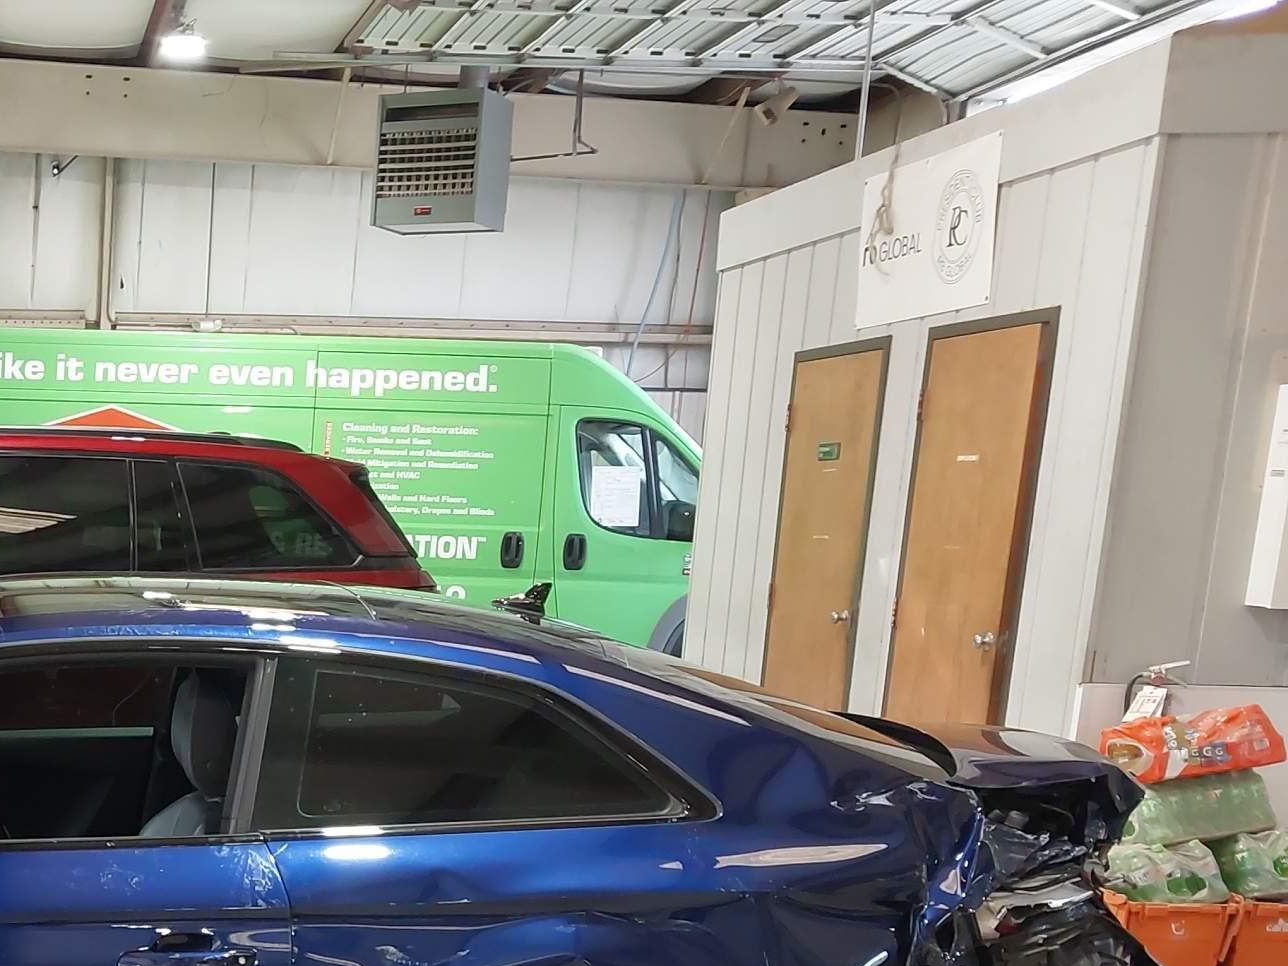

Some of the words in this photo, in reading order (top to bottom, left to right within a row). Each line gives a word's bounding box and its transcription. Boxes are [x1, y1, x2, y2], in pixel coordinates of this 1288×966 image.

[879, 232, 922, 262] GLOBAL
[55, 353, 83, 381] it
[95, 360, 200, 384] never
[208, 363, 294, 386] even
[343, 423, 388, 435] Cleaning
[390, 424, 410, 434] and
[412, 424, 479, 436] Restoration:
[346, 435, 365, 445] Fire,
[366, 436, 394, 445] Smoke
[395, 437, 411, 445] and
[346, 446, 373, 455] Water
[374, 447, 408, 457] Removal
[409, 448, 424, 457] and
[411, 461, 426, 469] and
[379, 471, 395, 479] and
[396, 471, 420, 480] HVAC
[402, 494, 418, 503] and
[452, 506, 469, 515] and
